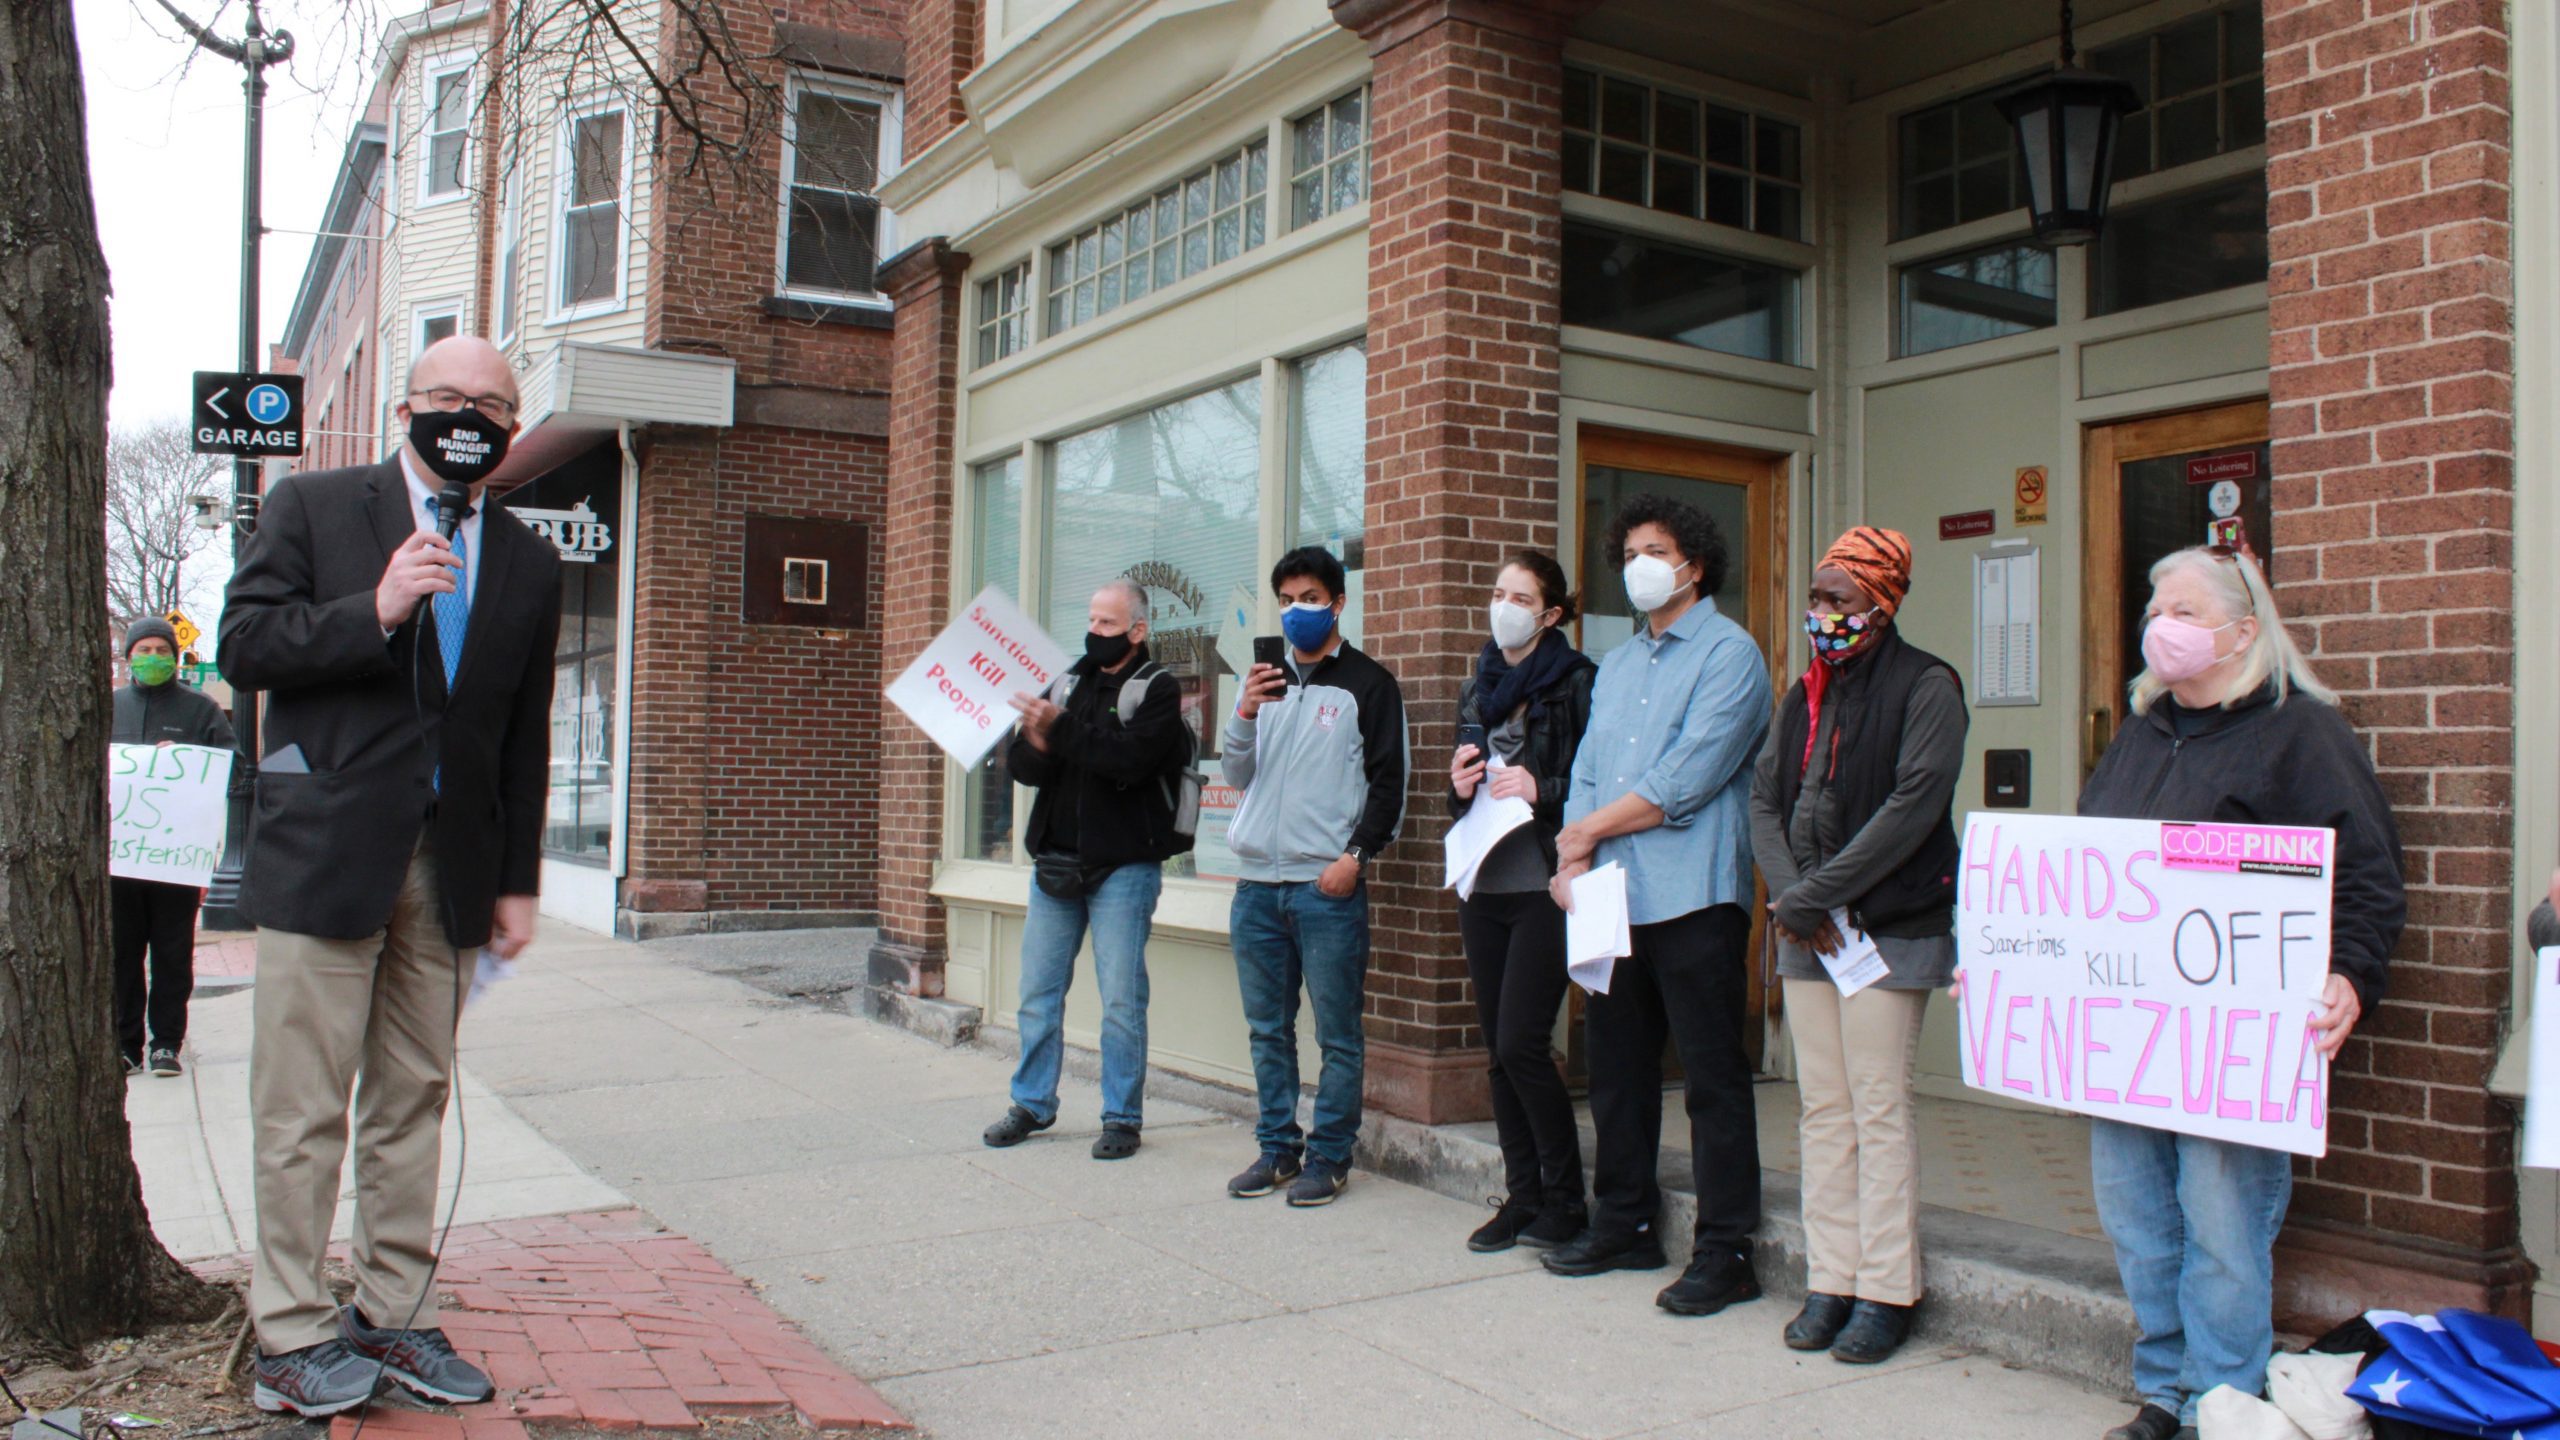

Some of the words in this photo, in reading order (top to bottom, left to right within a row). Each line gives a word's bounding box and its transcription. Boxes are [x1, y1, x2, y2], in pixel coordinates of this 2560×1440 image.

[258, 391, 280, 415] P
[197, 427, 297, 447] GARAGE
[437, 437, 491, 454] HUNGER
[452, 428, 480, 442] END
[444, 450, 482, 465] NOW!
[2192, 466, 2207, 477] No
[2209, 462, 2249, 474] Loitering
[1944, 521, 1956, 532] No
[1957, 519, 1990, 530] Loitering
[969, 604, 1052, 684] Sanctions
[967, 650, 1007, 688] Kill
[926, 662, 992, 731] People
[112, 745, 227, 785] SIST
[1964, 823, 2161, 923] HANDS
[2172, 908, 2317, 990] OFF
[1977, 925, 2067, 958] Sanctions
[2085, 950, 2146, 987] KILL
[1961, 969, 2325, 1131] VENEZUELA
